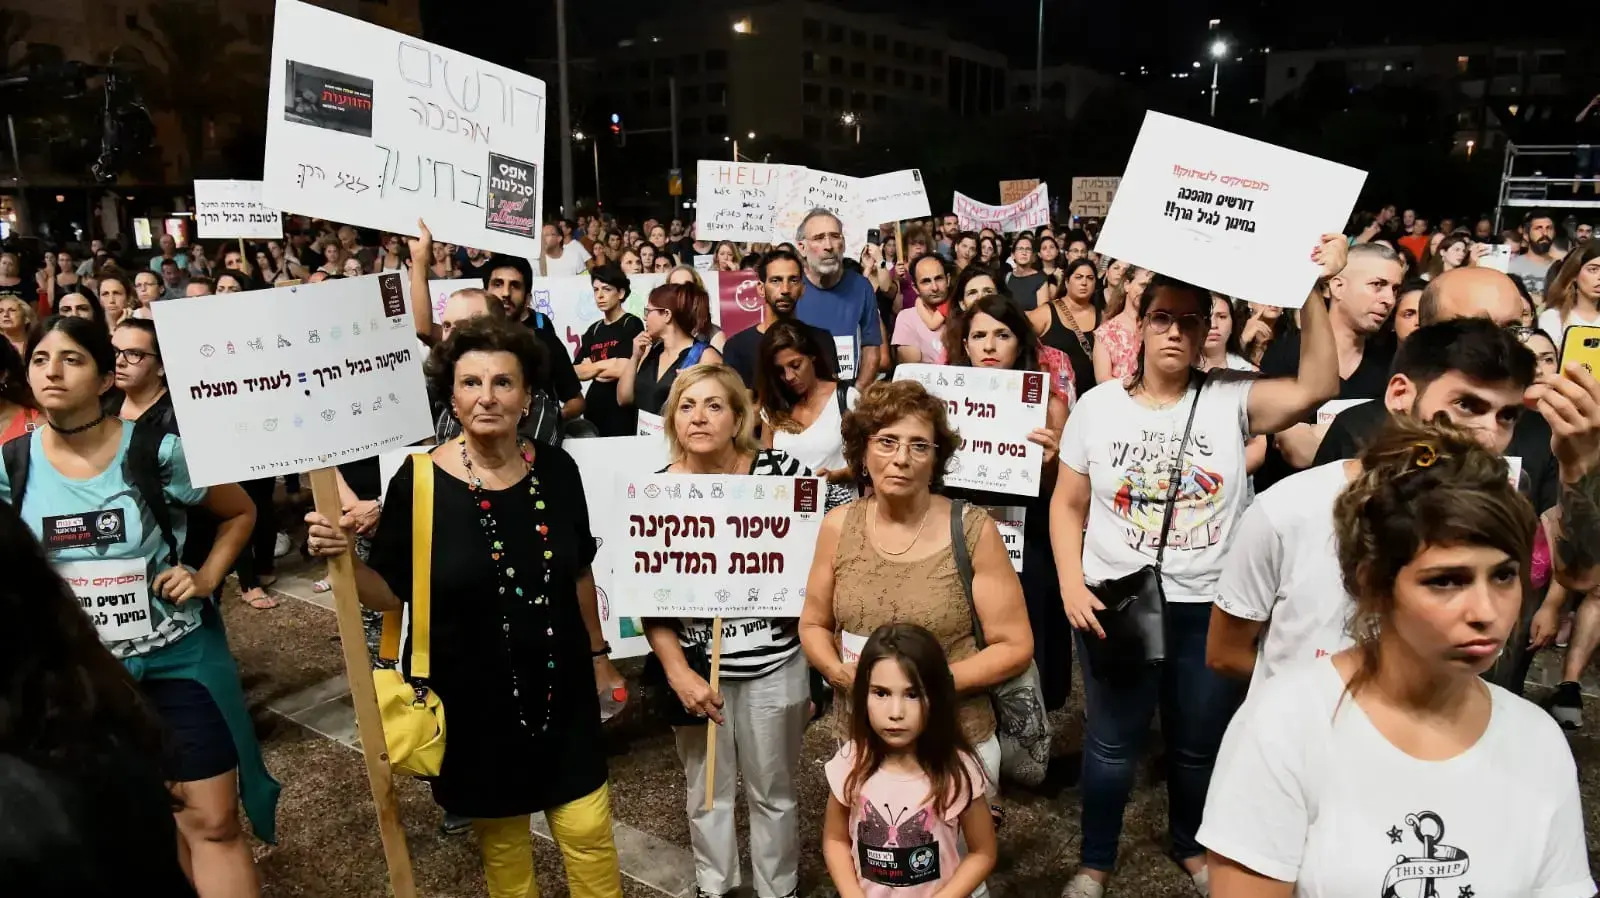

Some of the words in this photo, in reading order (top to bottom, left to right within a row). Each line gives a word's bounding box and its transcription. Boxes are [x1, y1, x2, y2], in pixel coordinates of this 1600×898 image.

[397, 40, 544, 133] דורשים
[499, 164, 527, 181] אפס
[491, 176, 533, 197] סבלנות
[1220, 175, 1270, 192] מפסיקים
[1177, 187, 1214, 205] מהפכה
[1215, 194, 1255, 213] דורשים
[200, 213, 220, 227] הרך
[223, 210, 245, 223] הגיל
[250, 211, 278, 223] לטובת
[1163, 200, 1194, 222] הרך!!
[1197, 207, 1221, 226] לגיל
[1224, 216, 1257, 234] בחינוך
[345, 358, 373, 376] בגיל
[375, 348, 411, 372] השקעה
[243, 370, 292, 393] לעתיד
[312, 365, 343, 389] הרך
[189, 379, 238, 401] מוצלח
[965, 397, 996, 419] הגיל
[318, 451, 338, 463] למן
[998, 442, 1027, 459] בסיס
[629, 514, 715, 548] התקינה
[726, 515, 791, 539] שיפור
[634, 550, 718, 575] המדינה
[728, 551, 785, 575] חובת
[93, 575, 145, 588] מפסיקים
[97, 592, 136, 607] דורשים
[113, 609, 147, 627] בחינוך
[740, 619, 768, 637] בחינוך
[1395, 865, 1424, 877] THIS
[1429, 863, 1461, 875] SHIP
